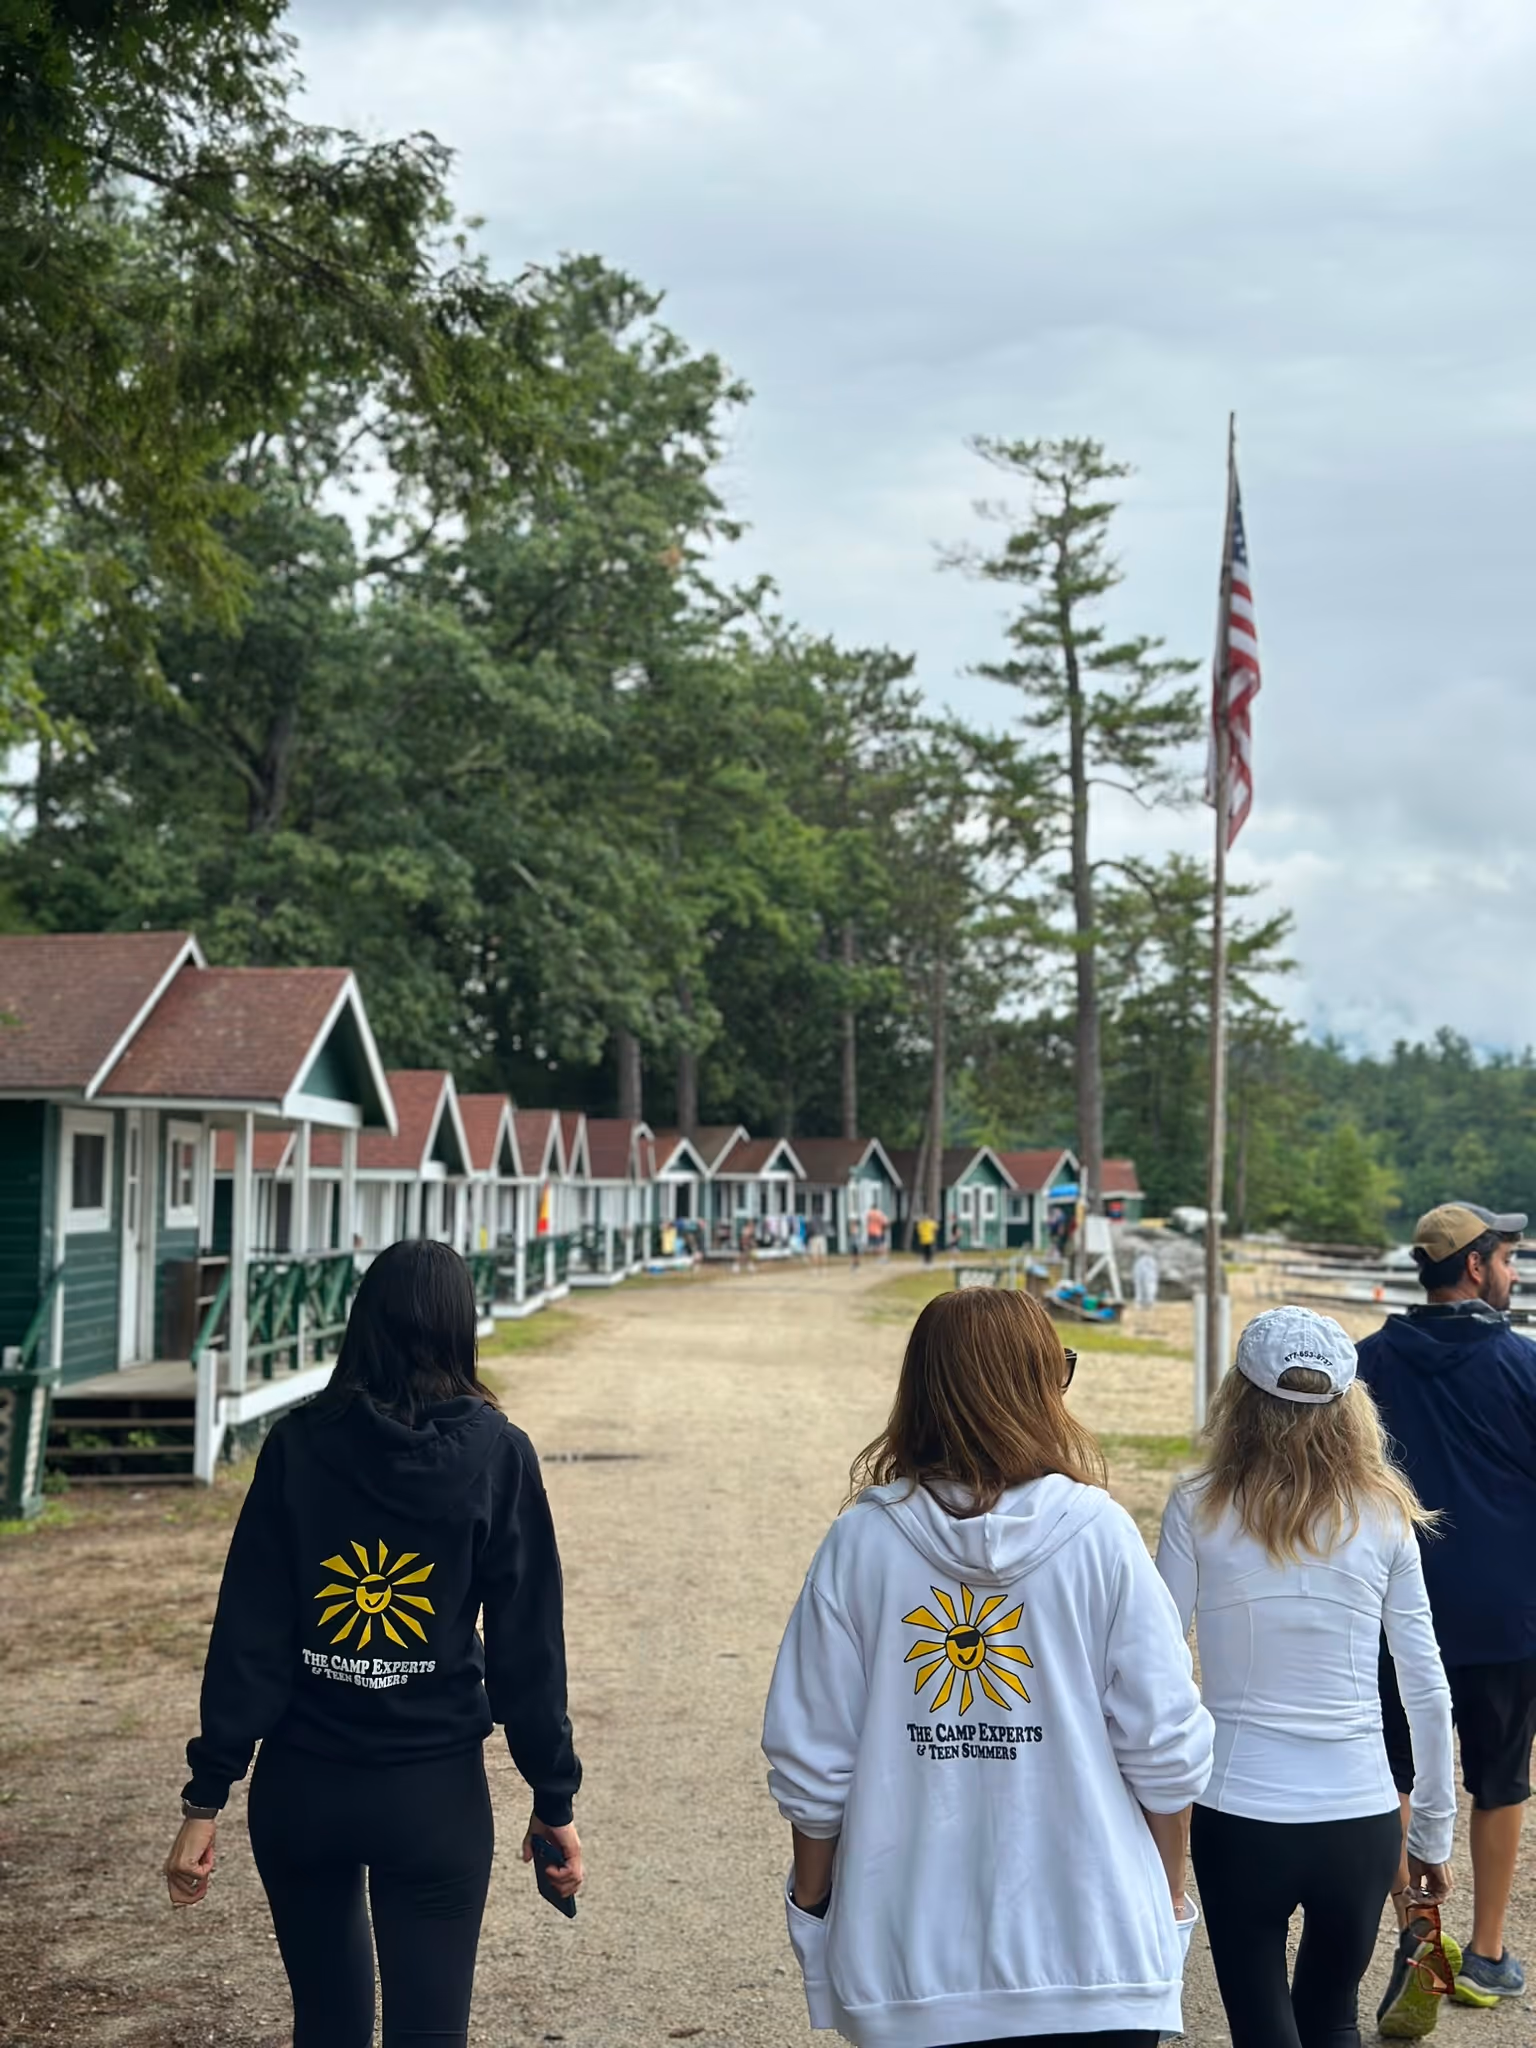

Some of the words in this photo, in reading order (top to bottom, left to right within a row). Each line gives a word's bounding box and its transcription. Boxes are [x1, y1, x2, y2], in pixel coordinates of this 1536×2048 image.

[302, 1649, 328, 1667] THE
[331, 1655, 370, 1675] CAMP
[372, 1658, 436, 1675] EXPERTS
[311, 1666, 322, 1675] &
[324, 1668, 353, 1683] TEEN
[353, 1674, 408, 1690] SUMMERS
[907, 1723, 933, 1742] THE
[935, 1723, 977, 1742] CAMP
[978, 1723, 1043, 1743] EXPERTS
[916, 1744, 925, 1757] &
[929, 1744, 959, 1760] TEEN
[961, 1743, 1017, 1761] SUMMERS
